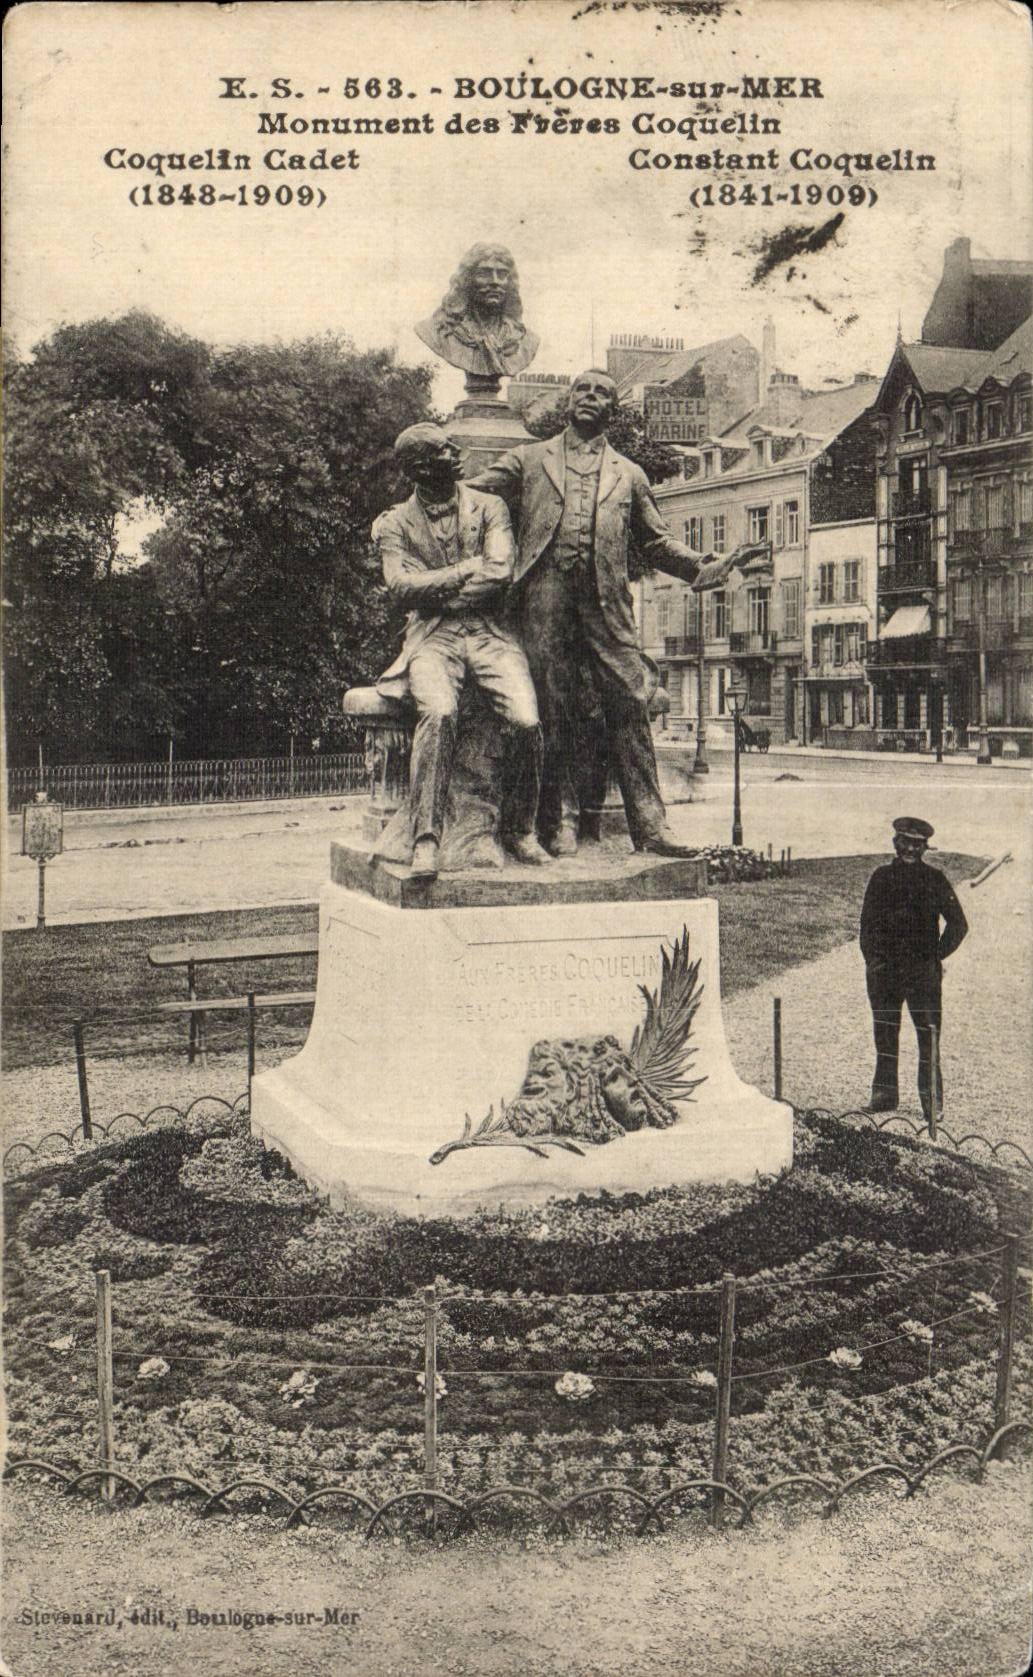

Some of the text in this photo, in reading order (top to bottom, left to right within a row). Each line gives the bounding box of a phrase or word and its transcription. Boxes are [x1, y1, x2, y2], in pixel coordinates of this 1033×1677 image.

[649, 400, 706, 416] HOTEL
[648, 423, 706, 440] MARINE
[564, 952, 661, 982] COQUELIN
